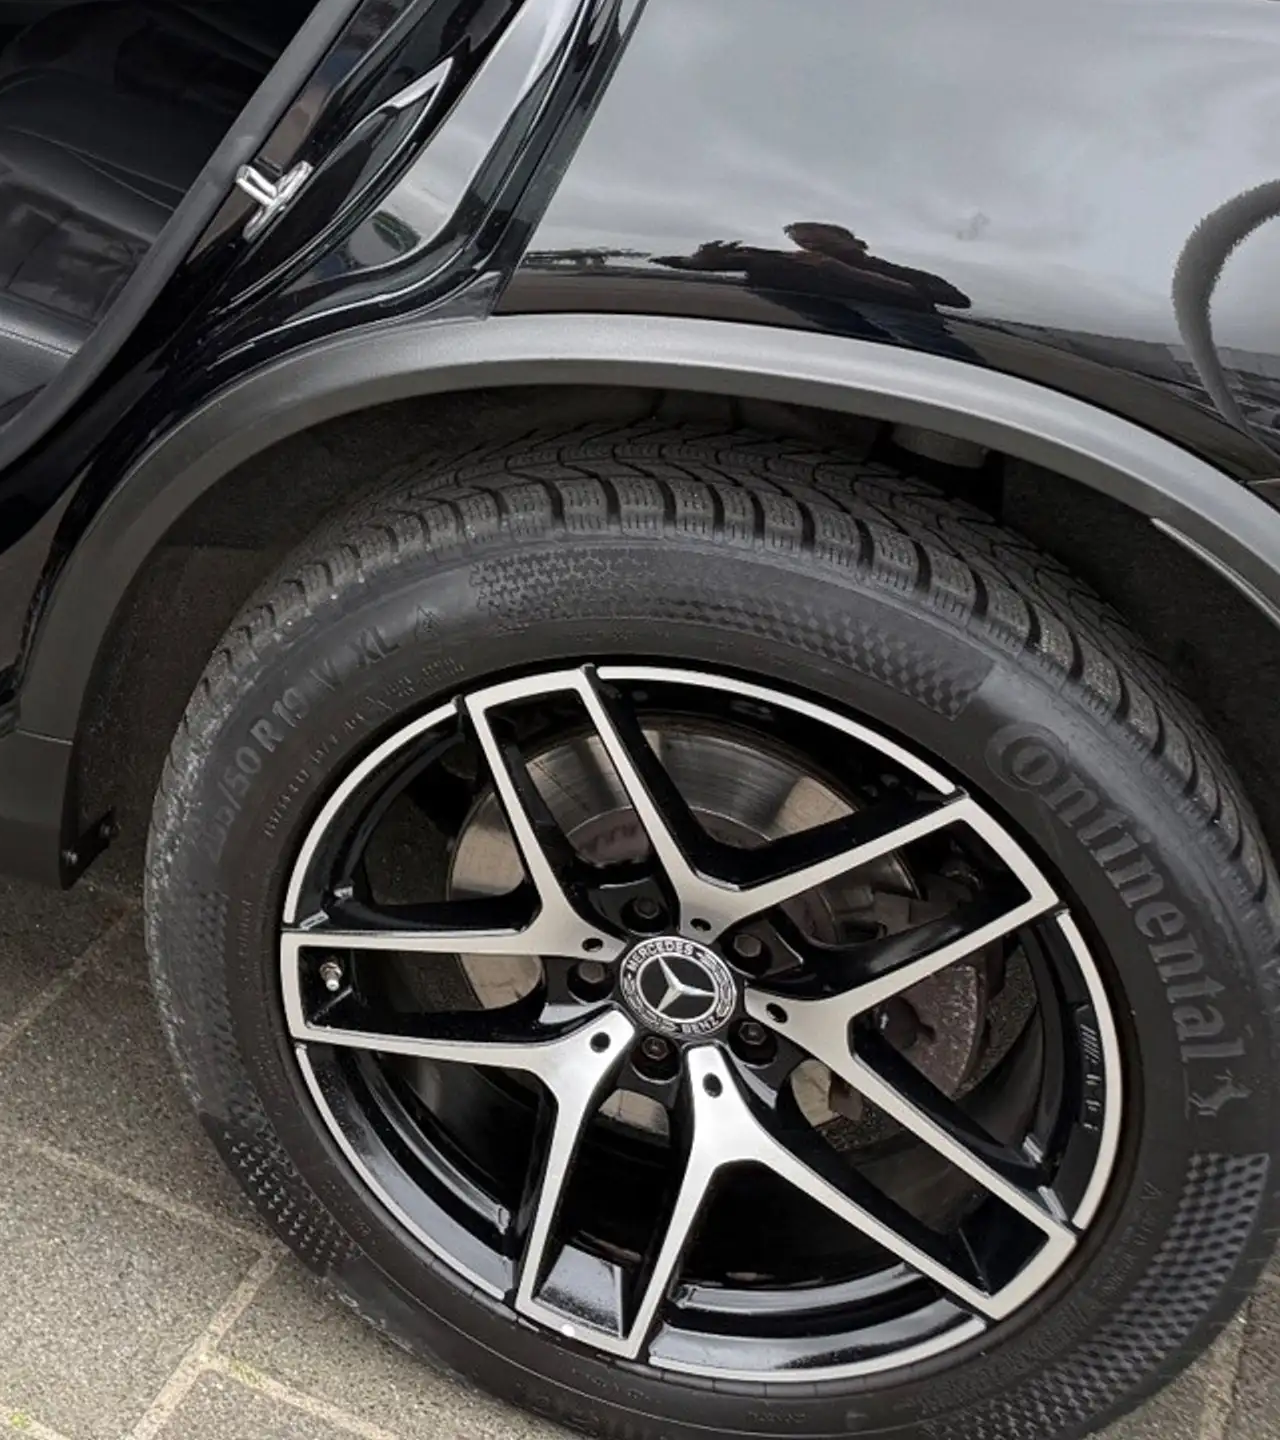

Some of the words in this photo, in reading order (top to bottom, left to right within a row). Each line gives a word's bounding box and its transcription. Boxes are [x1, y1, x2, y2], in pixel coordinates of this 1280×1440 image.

[985, 723, 1247, 1063] Continental
[626, 941, 694, 972] MERCEDES
[681, 1017, 720, 1034] BENZ
